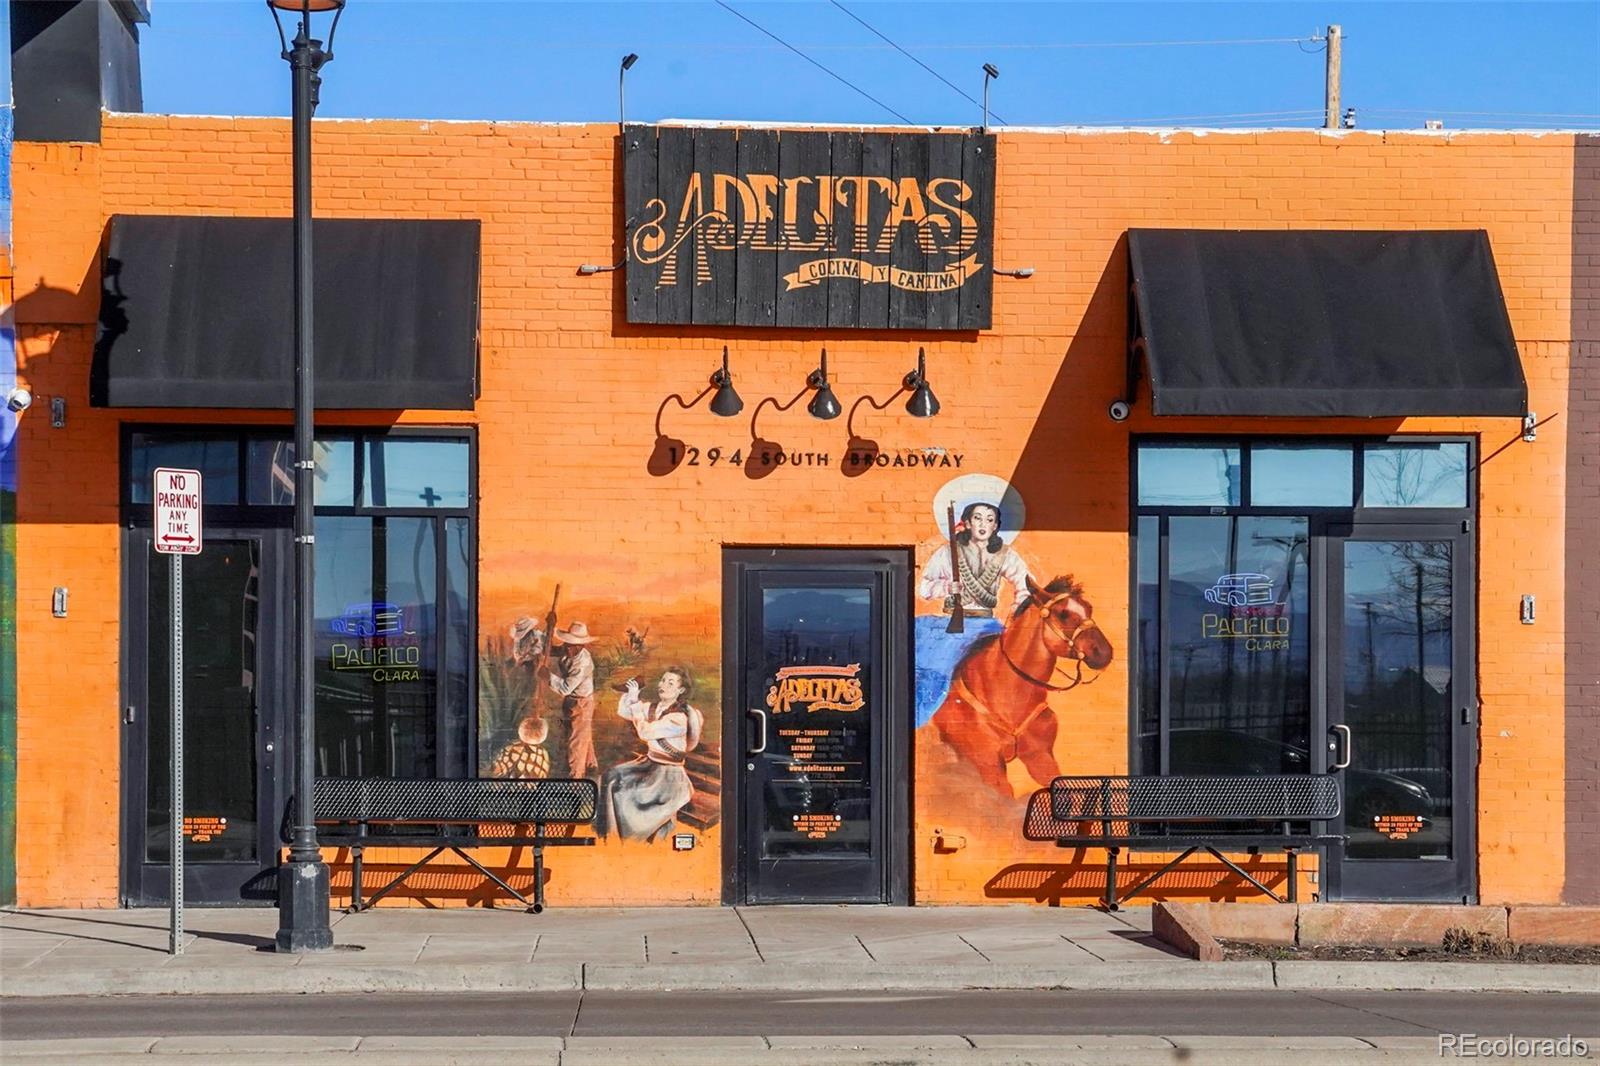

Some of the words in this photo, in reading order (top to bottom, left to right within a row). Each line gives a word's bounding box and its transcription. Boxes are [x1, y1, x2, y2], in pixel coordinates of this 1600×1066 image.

[633, 172, 979, 289] ADELITAS
[809, 260, 859, 278] COCINA
[878, 267, 887, 280] Y
[898, 272, 957, 290] CANTINA
[669, 448, 743, 466] 1294
[761, 452, 828, 466] SOUTH
[850, 452, 964, 468] BROADWAY
[170, 475, 185, 490] NO
[158, 492, 197, 509] PARKING
[169, 510, 187, 520] ANY
[168, 523, 189, 533] TIME
[373, 669, 420, 681] CLARA
